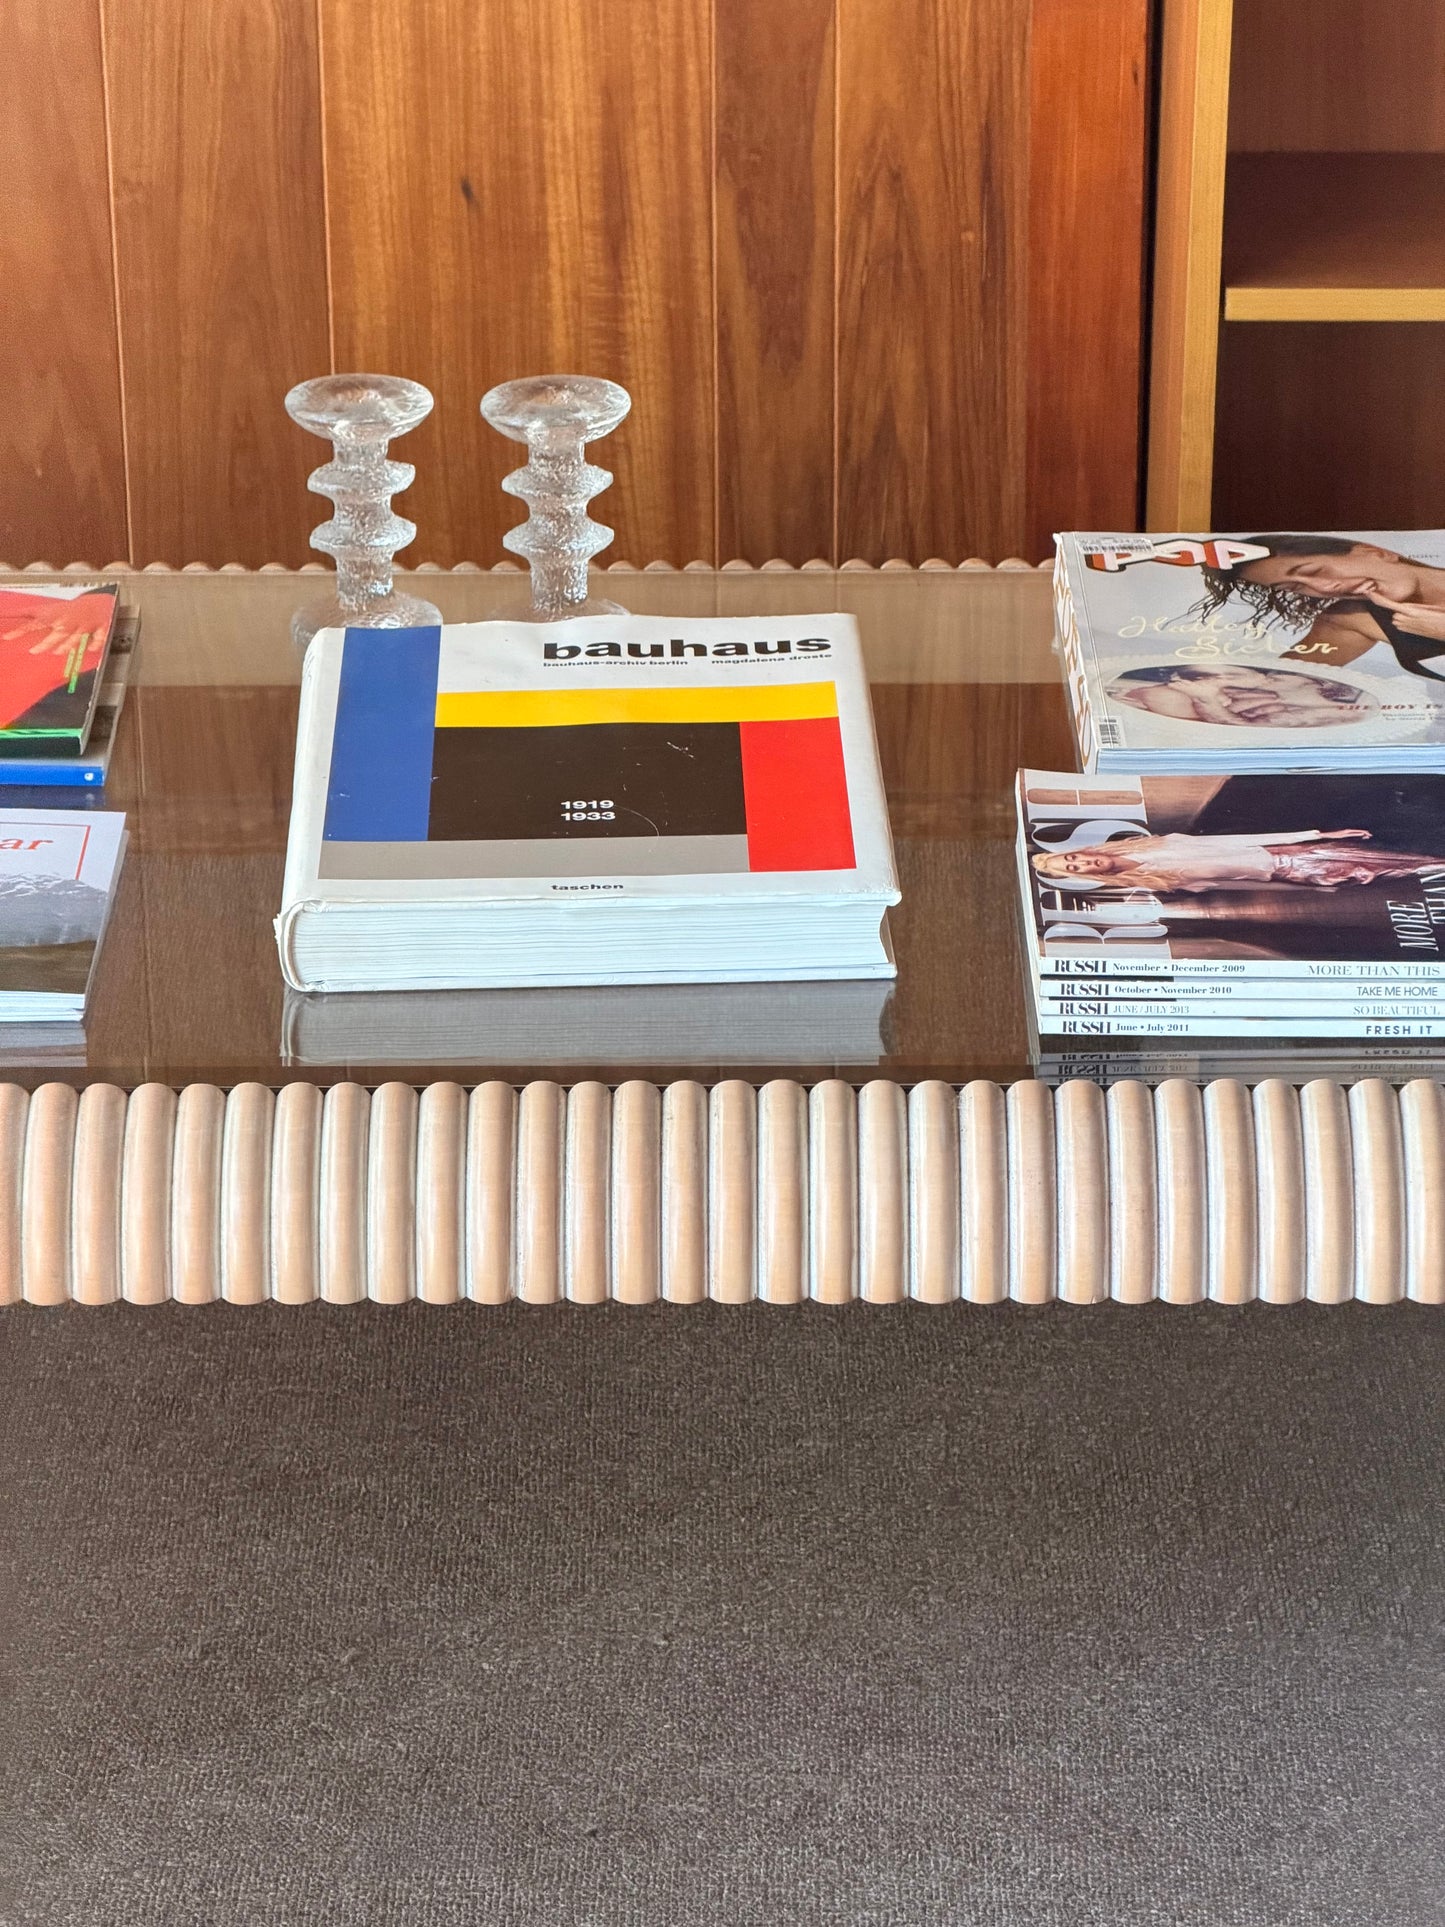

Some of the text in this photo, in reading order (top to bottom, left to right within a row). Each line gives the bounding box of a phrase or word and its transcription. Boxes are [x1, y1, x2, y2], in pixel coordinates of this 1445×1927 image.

[543, 638, 831, 660] bauhaus
[560, 799, 615, 810] 1919
[560, 811, 616, 821] 1933
[1387, 900, 1439, 951] MORE
[1054, 959, 1246, 973] RUSSH November December 2009
[1307, 965, 1441, 976] MORE THAN THIS
[1060, 983, 1232, 996] RUSSH October November 2010
[1357, 986, 1438, 996] TAKE ME HOME
[1059, 1002, 1109, 1015] RUSSH
[1113, 1006, 1138, 1014] JUNE
[1144, 1006, 1167, 1014] JULY
[1170, 1006, 1190, 1014] 2013
[1353, 1005, 1441, 1016] SO BEAUTIFUL
[1062, 1020, 1189, 1034] RUSSH June July 2011
[1366, 1025, 1433, 1035] FRESH IT
